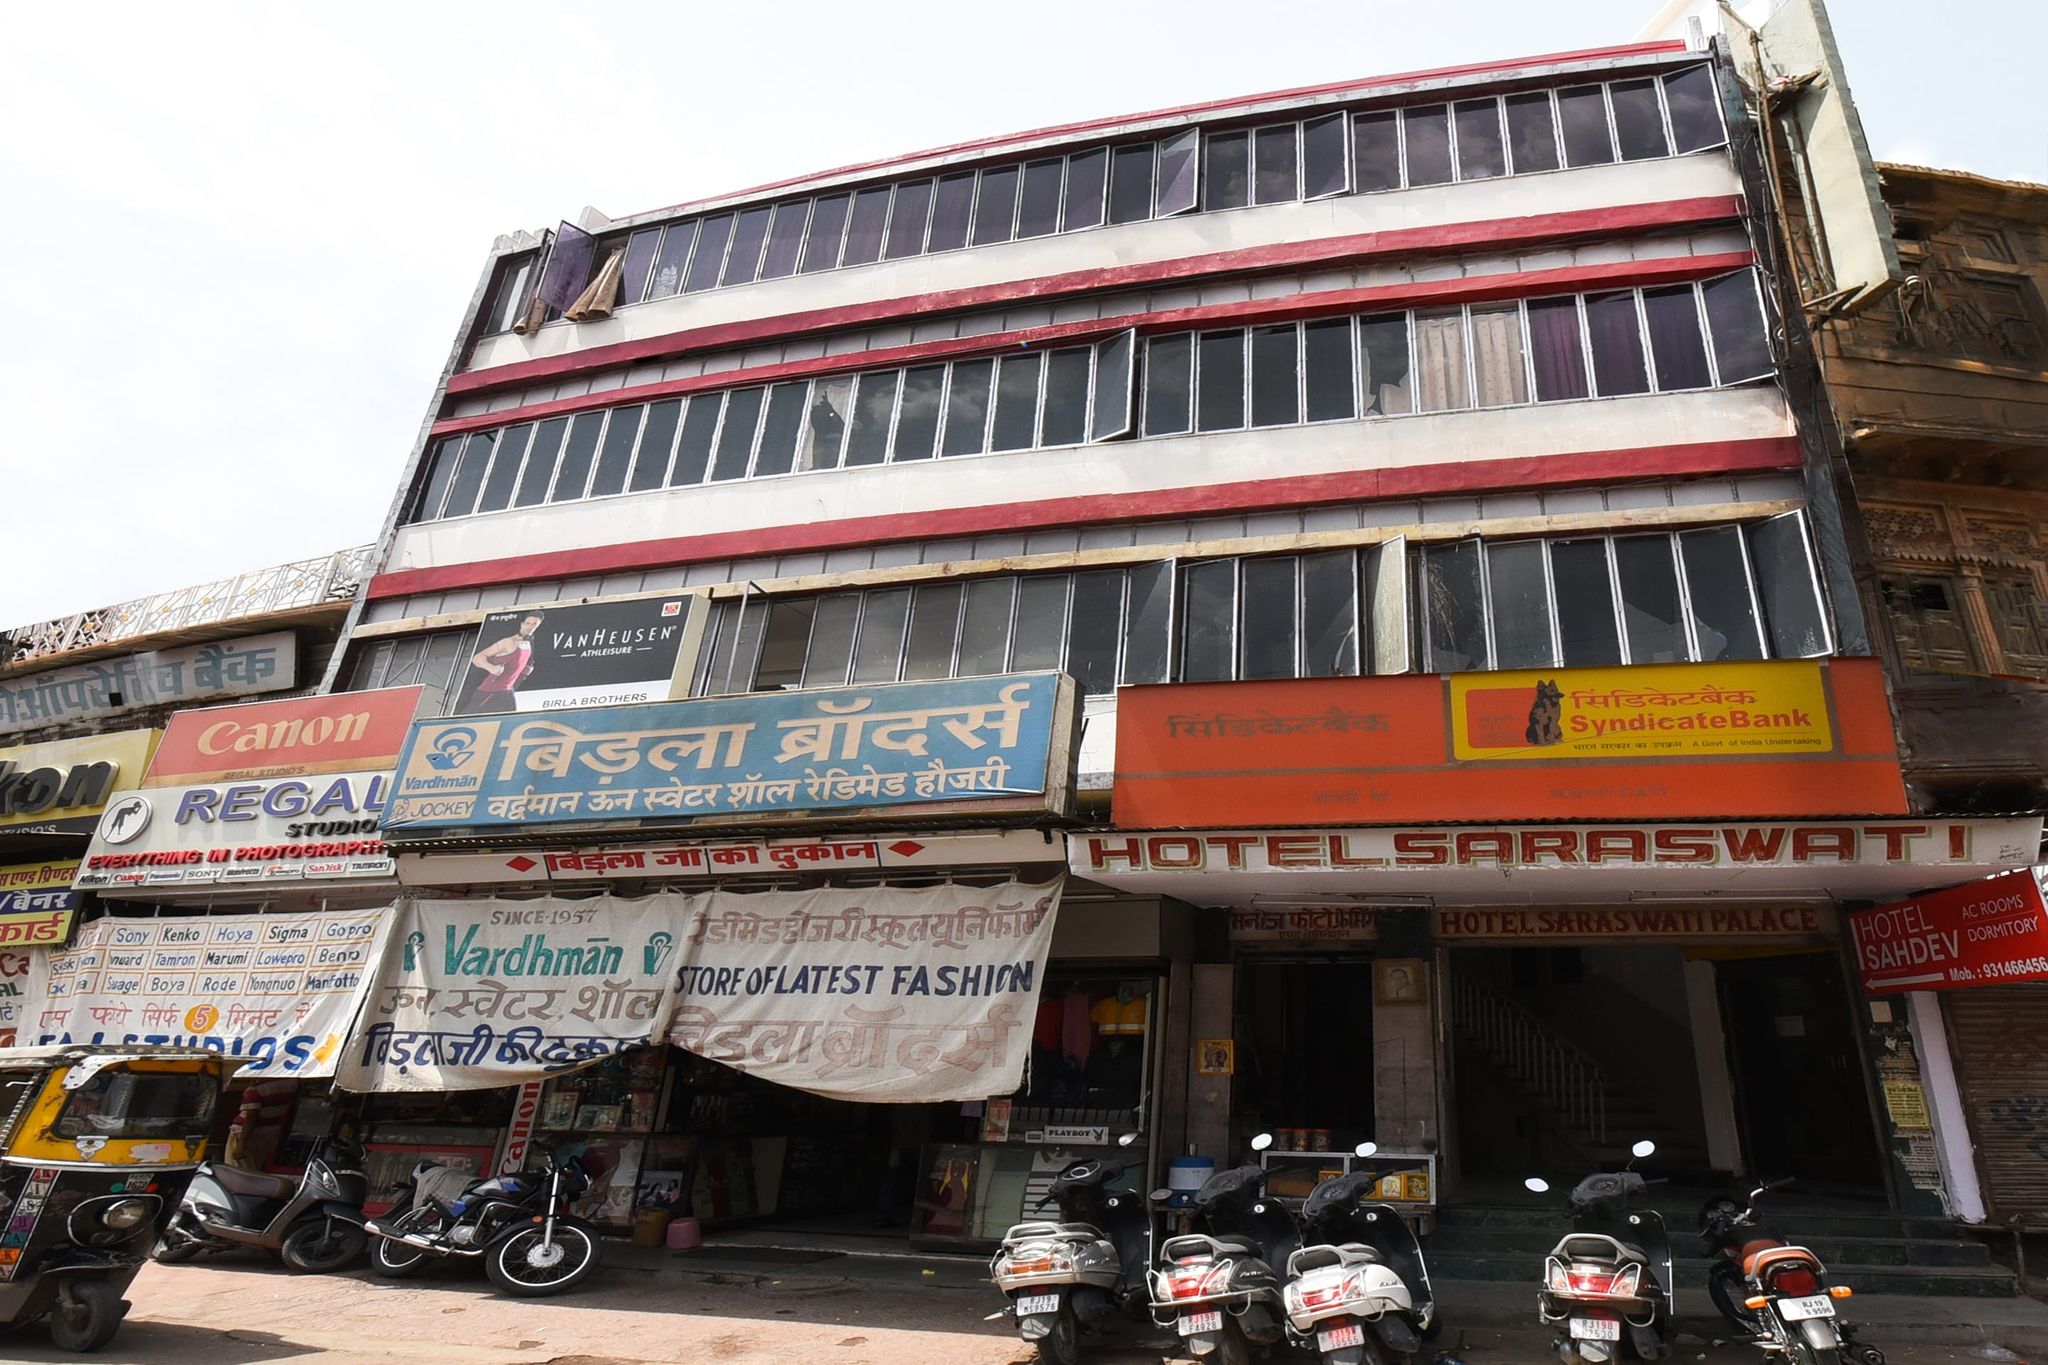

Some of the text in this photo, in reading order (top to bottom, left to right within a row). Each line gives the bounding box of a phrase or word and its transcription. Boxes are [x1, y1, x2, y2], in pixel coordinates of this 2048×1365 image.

[580, 646, 633, 658] ATHLEISURE
[194, 645, 276, 691] बैंक
[542, 693, 648, 709] BIRLA BROTHERS
[197, 711, 372, 756] Canon
[1570, 708, 1813, 737] SyndicateBank
[1728, 738, 1738, 747] of
[1740, 737, 1763, 746] India
[1765, 736, 1822, 746] Undertaking
[588, 789, 638, 812] ऊन
[643, 777, 722, 811] स्वेटर
[727, 773, 800, 806] शॉल
[806, 764, 907, 801] रेडिमेड
[912, 756, 1011, 798] हौजरी
[174, 775, 387, 825] REGAL
[411, 800, 474, 817] JOCKEY
[87, 840, 384, 869] EVERYTHING IN PHOTOGRAPHY
[770, 843, 876, 869] दुकान
[1089, 826, 1973, 872] HOTEL SARASWATI
[114, 874, 145, 882] Canon
[187, 870, 220, 878] SONY
[352, 861, 388, 871] TAMRON
[1962, 893, 2024, 920] AC ROOMS
[1440, 907, 1819, 934] HOTEL SARASWATI PALACE
[1860, 905, 1934, 942] HOTEL
[1967, 916, 2038, 942] DORMITORY
[117, 927, 149, 945] Sony
[162, 928, 200, 942] Kenko
[217, 928, 253, 943] Hoya
[269, 926, 308, 943] Sigma
[155, 953, 196, 966] Tamron
[207, 951, 249, 966] Marumi
[257, 951, 305, 967] Lowepro
[1866, 929, 1959, 970] SAHDEV
[151, 979, 185, 992] Boya
[203, 978, 236, 992] Rode
[674, 960, 1035, 996] STORE OF LATEST FASHION
[1950, 967, 1976, 982] Mob.
[142, 1003, 179, 1027] सिर्फ
[194, 1003, 210, 1030] 5
[227, 1006, 282, 1028] मिनट
[501, 1083, 540, 1175] Canon
